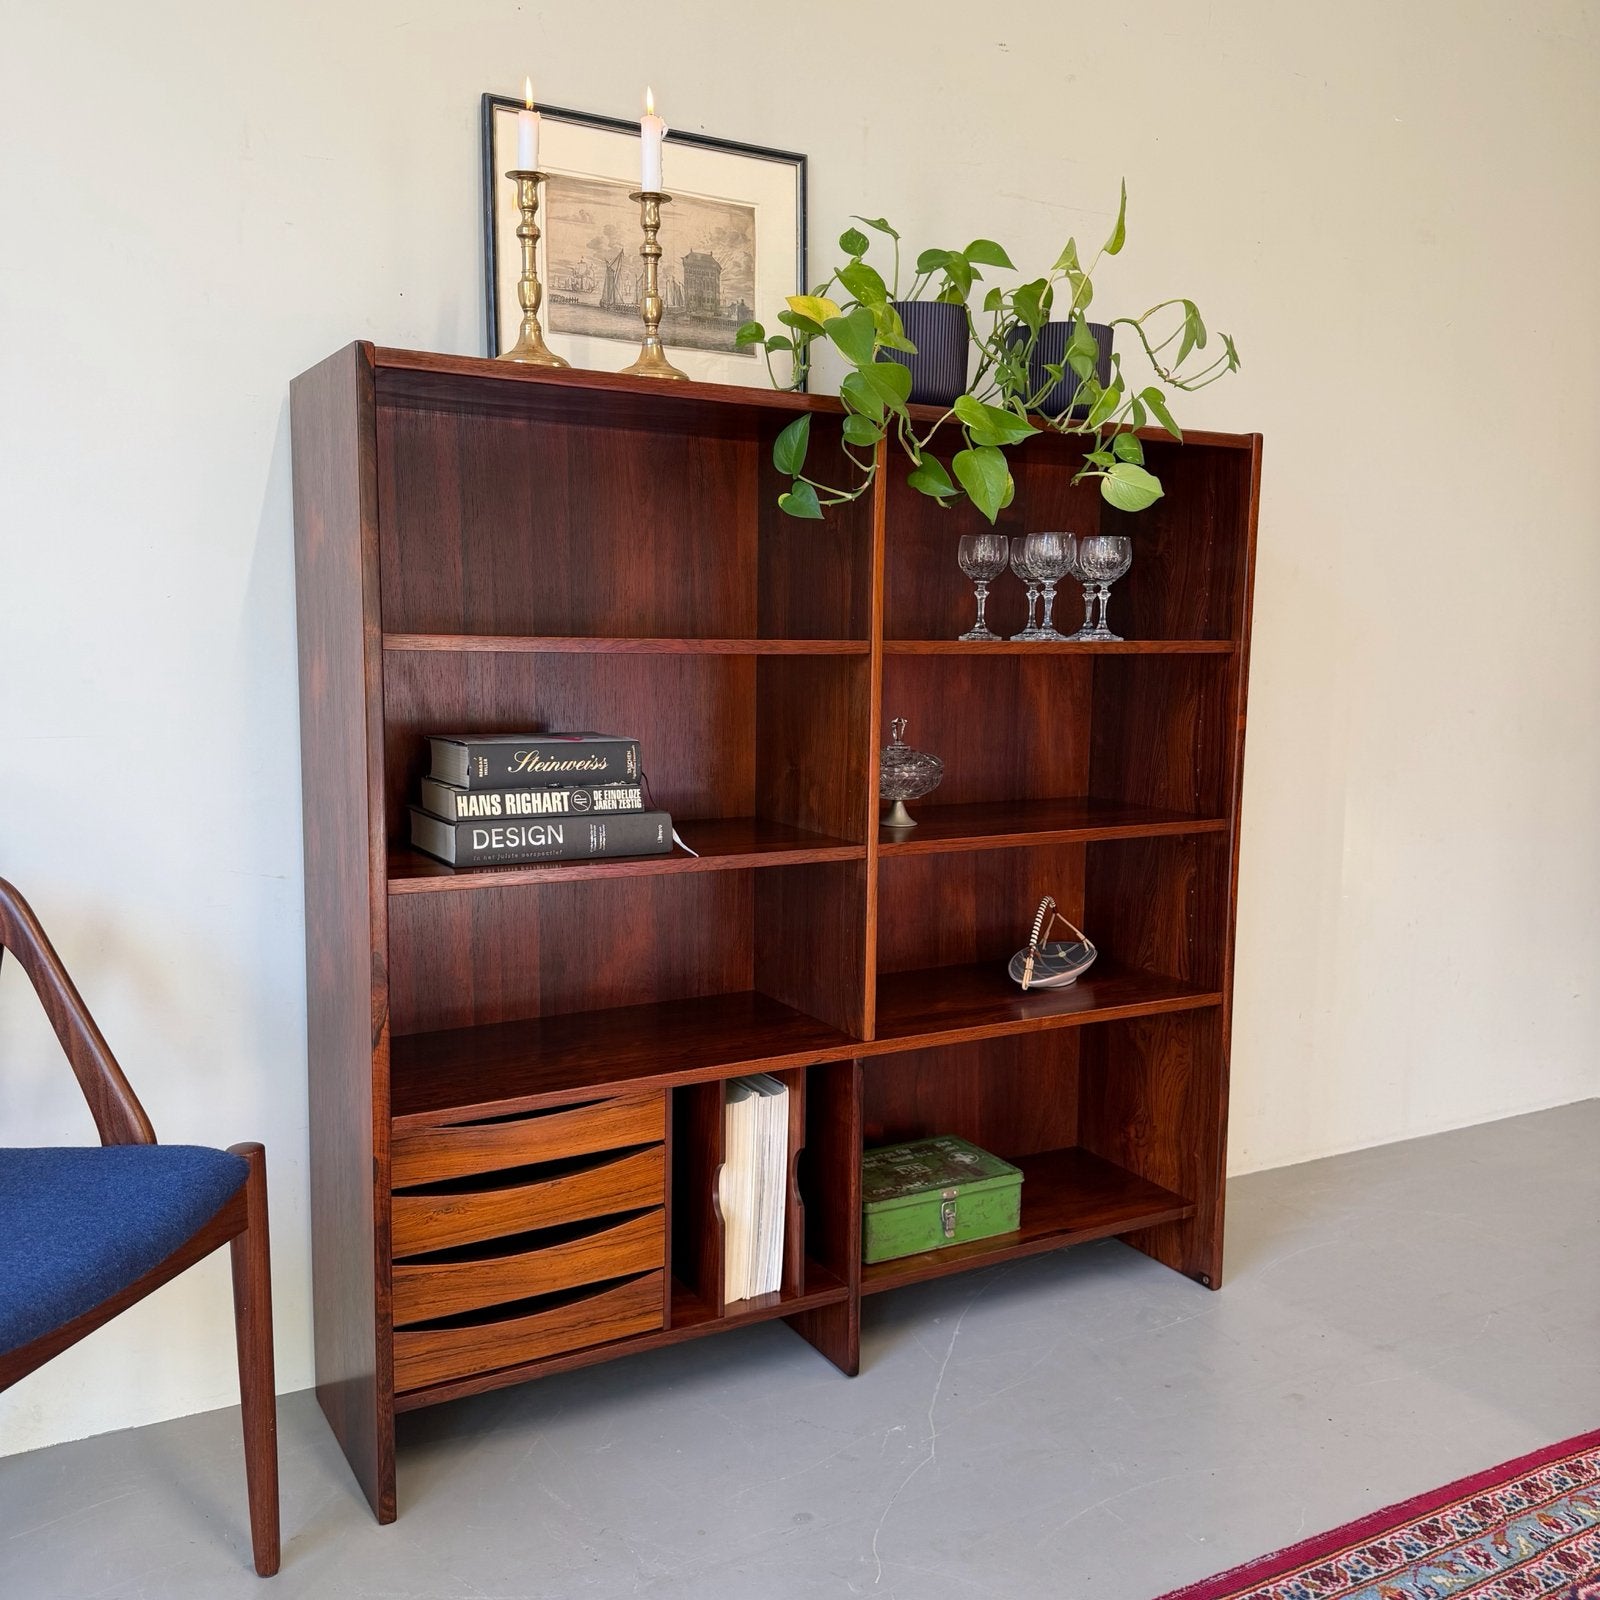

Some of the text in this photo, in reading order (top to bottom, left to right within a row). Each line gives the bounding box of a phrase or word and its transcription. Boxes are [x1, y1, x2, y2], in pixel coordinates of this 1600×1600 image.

[507, 749, 608, 773] Steinweiss
[456, 791, 570, 817] HANS RIGHART
[593, 788, 642, 801] DE EINDELOZE
[593, 798, 642, 810] JAREN ZESTIG
[472, 824, 564, 850] DESIGN
